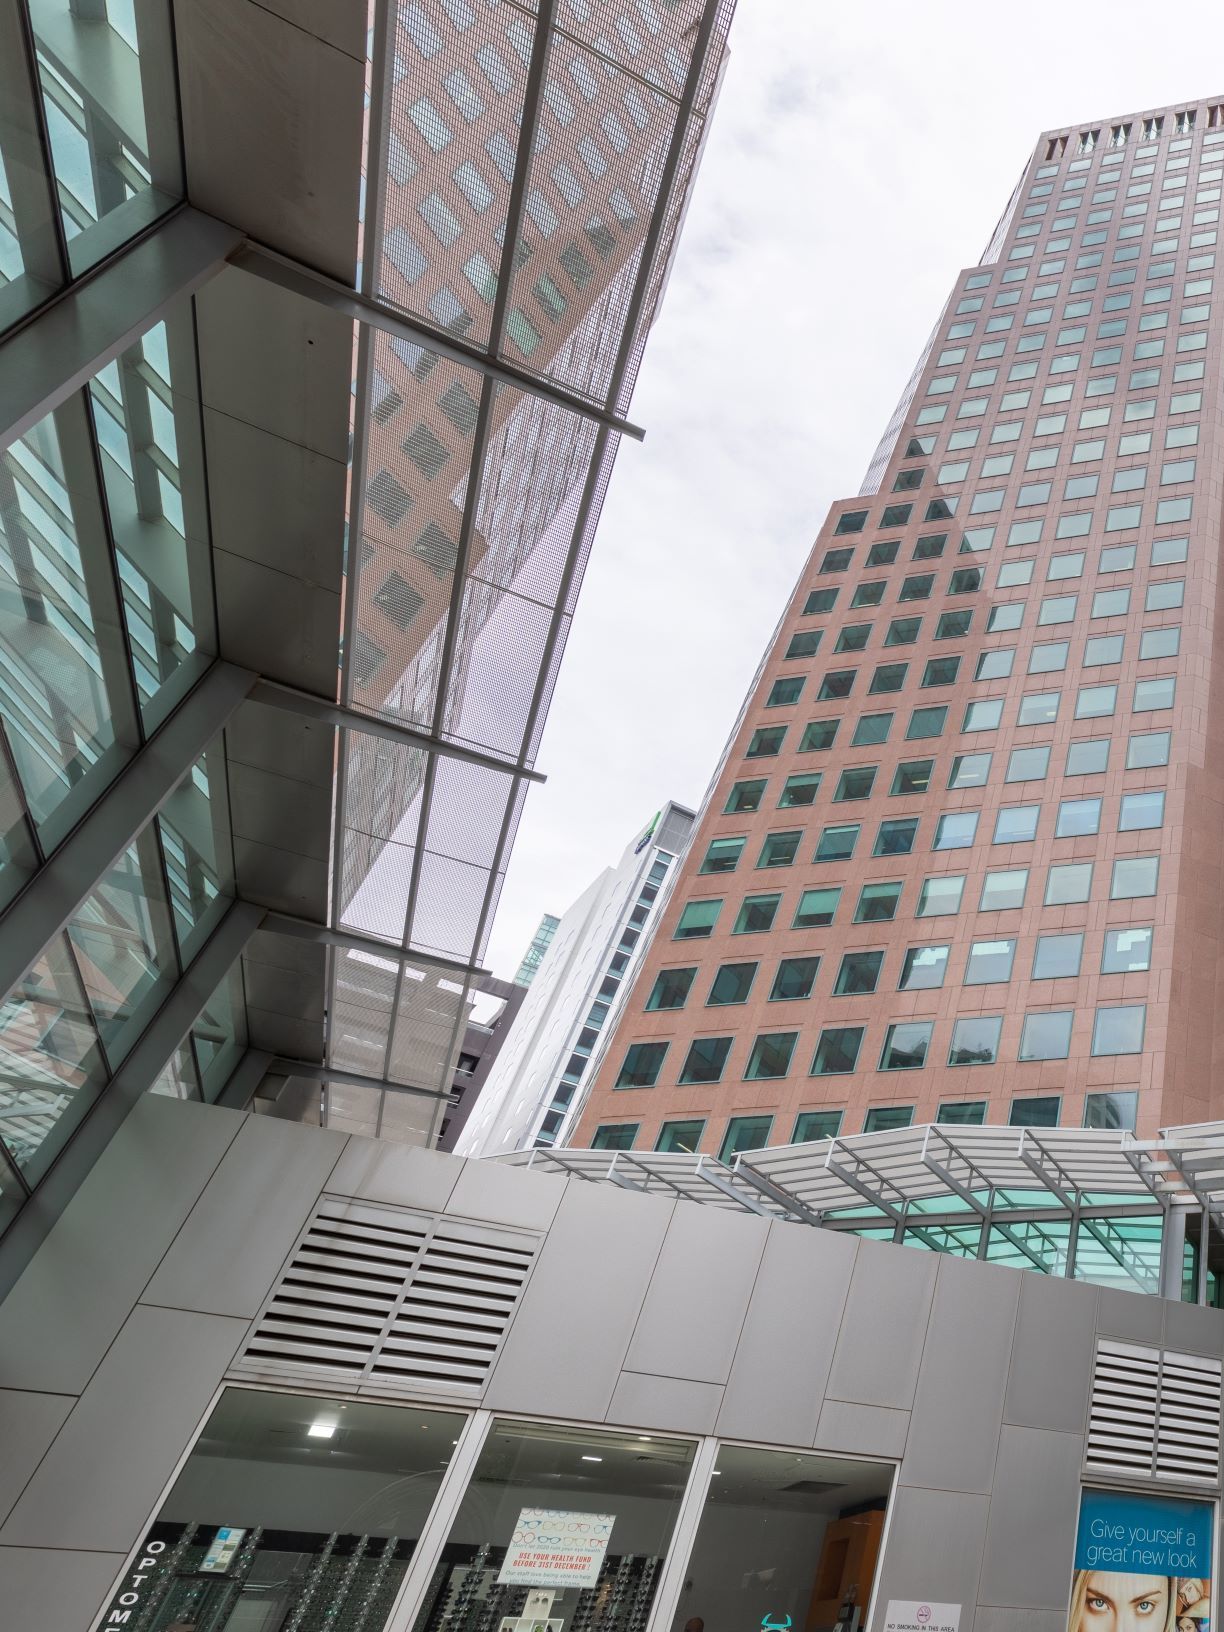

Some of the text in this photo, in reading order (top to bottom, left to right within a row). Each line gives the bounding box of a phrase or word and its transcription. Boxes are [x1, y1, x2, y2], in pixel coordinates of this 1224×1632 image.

[1090, 1518, 1196, 1547] Give yourself a
[512, 1559, 536, 1567] BEFORE
[554, 1562, 587, 1571] DECEMBER
[551, 1554, 574, 1562] HEALTH
[575, 1555, 592, 1563] FUND
[1086, 1545, 1197, 1568] great new look
